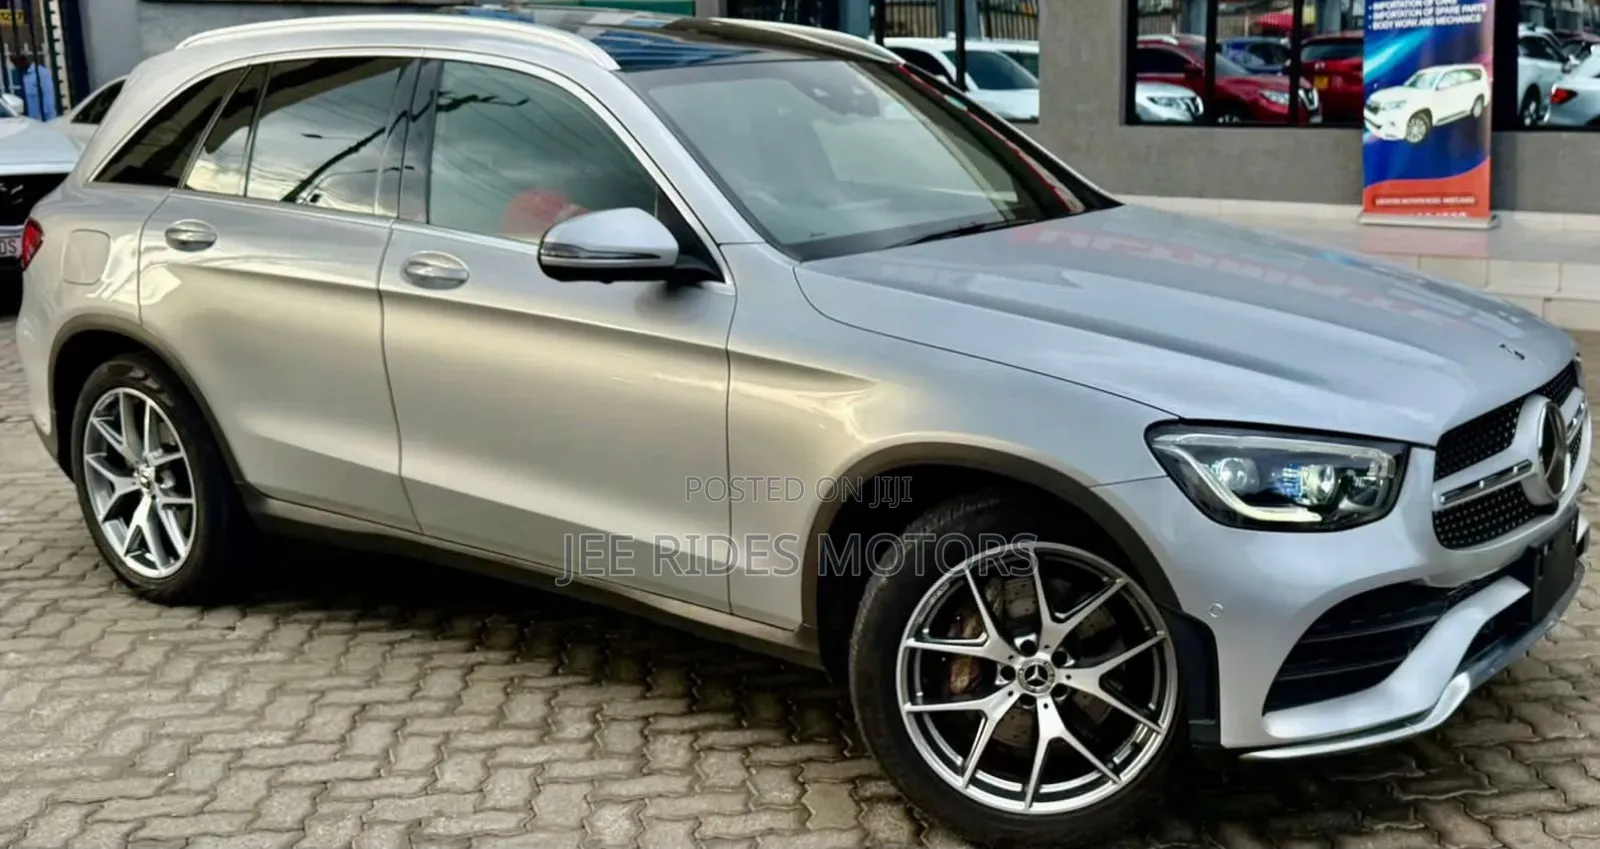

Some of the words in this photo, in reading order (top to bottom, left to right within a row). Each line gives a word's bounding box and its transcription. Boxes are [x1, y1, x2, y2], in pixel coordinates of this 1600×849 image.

[1373, 9, 1422, 20] IMPORTATION
[1423, 8, 1433, 17] OF
[1435, 5, 1460, 16] SPARE
[1462, 3, 1487, 14] PARTS
[1373, 20, 1393, 30] BODY
[1394, 19, 1418, 29] WORK
[1418, 18, 1434, 27] AND
